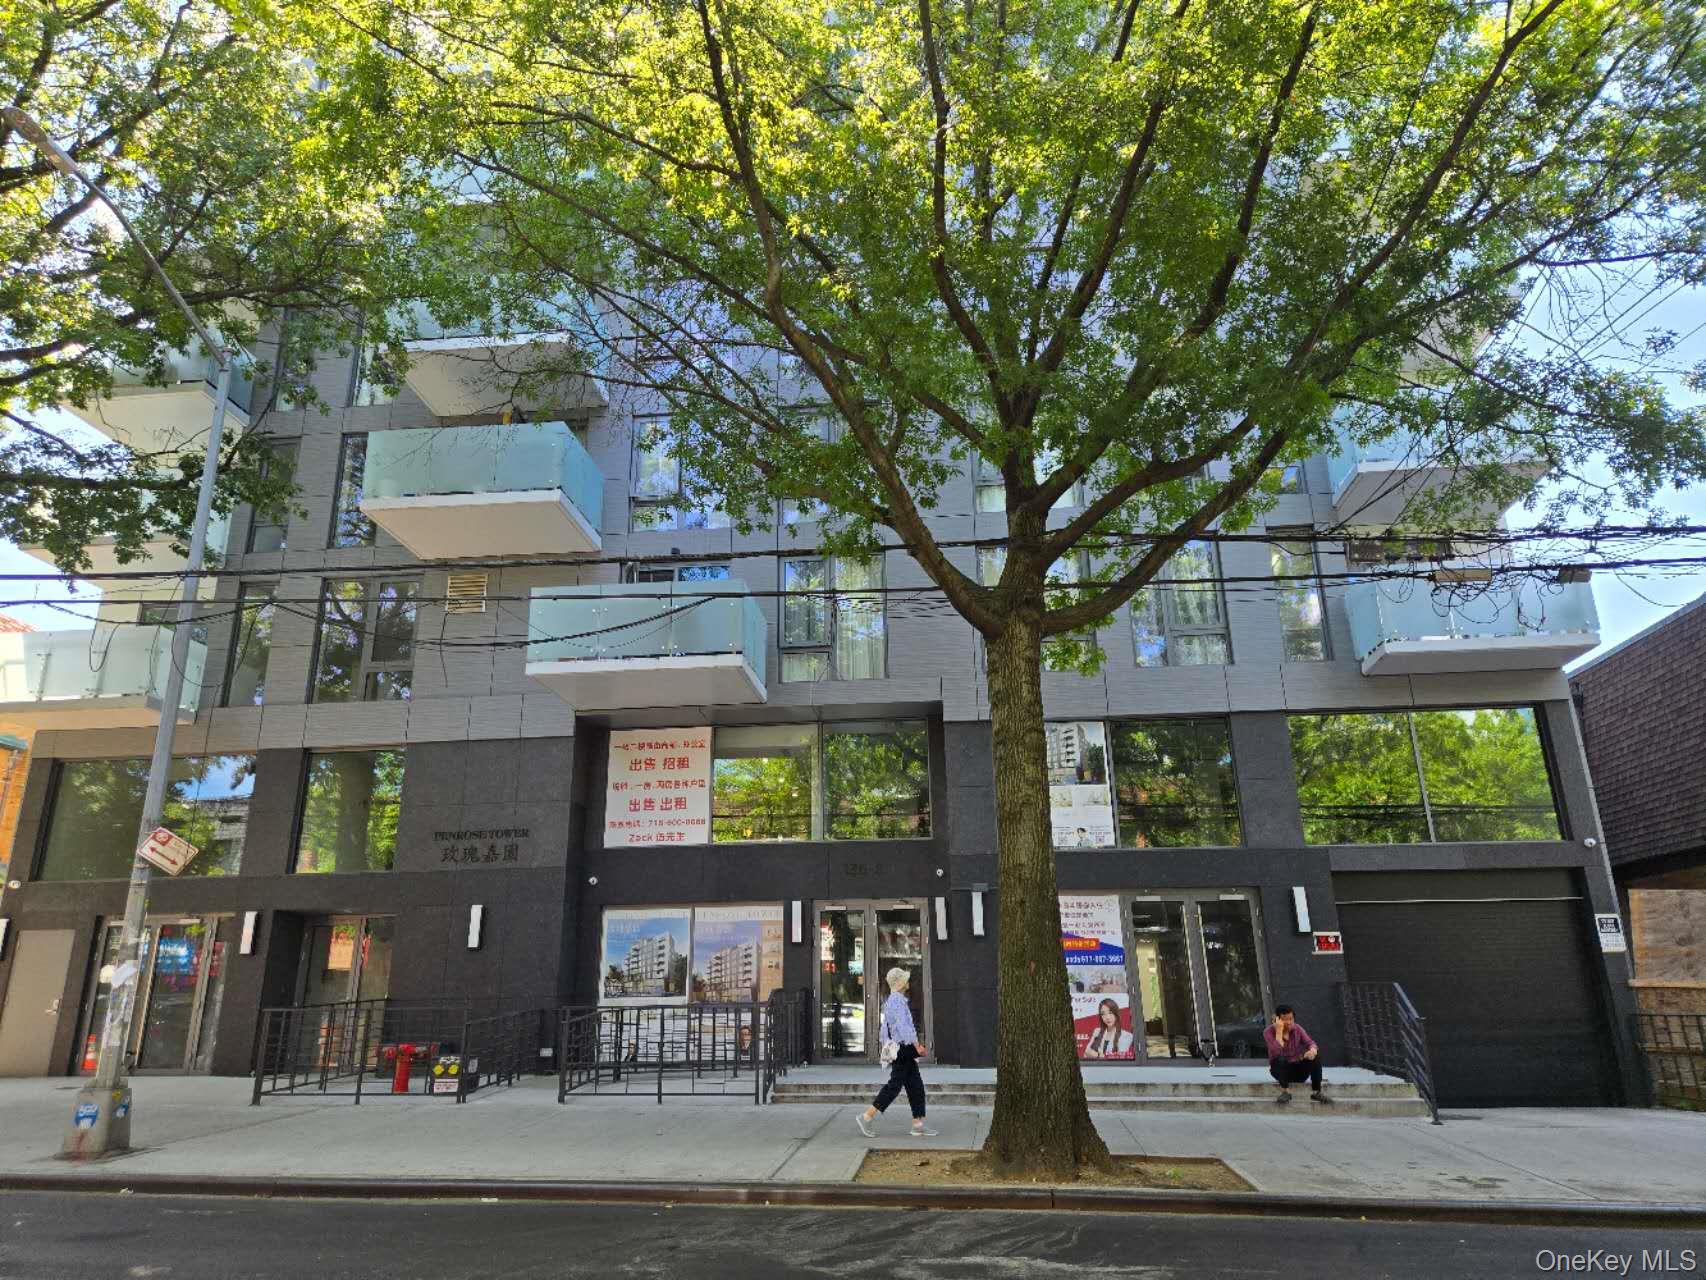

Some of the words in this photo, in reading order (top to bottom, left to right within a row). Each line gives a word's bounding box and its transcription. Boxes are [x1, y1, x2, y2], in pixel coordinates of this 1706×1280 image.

[629, 757, 656, 772] 出售
[662, 756, 690, 770] 招租
[628, 798, 656, 813] 出售
[659, 796, 688, 812] 出租
[628, 832, 653, 843] Zack
